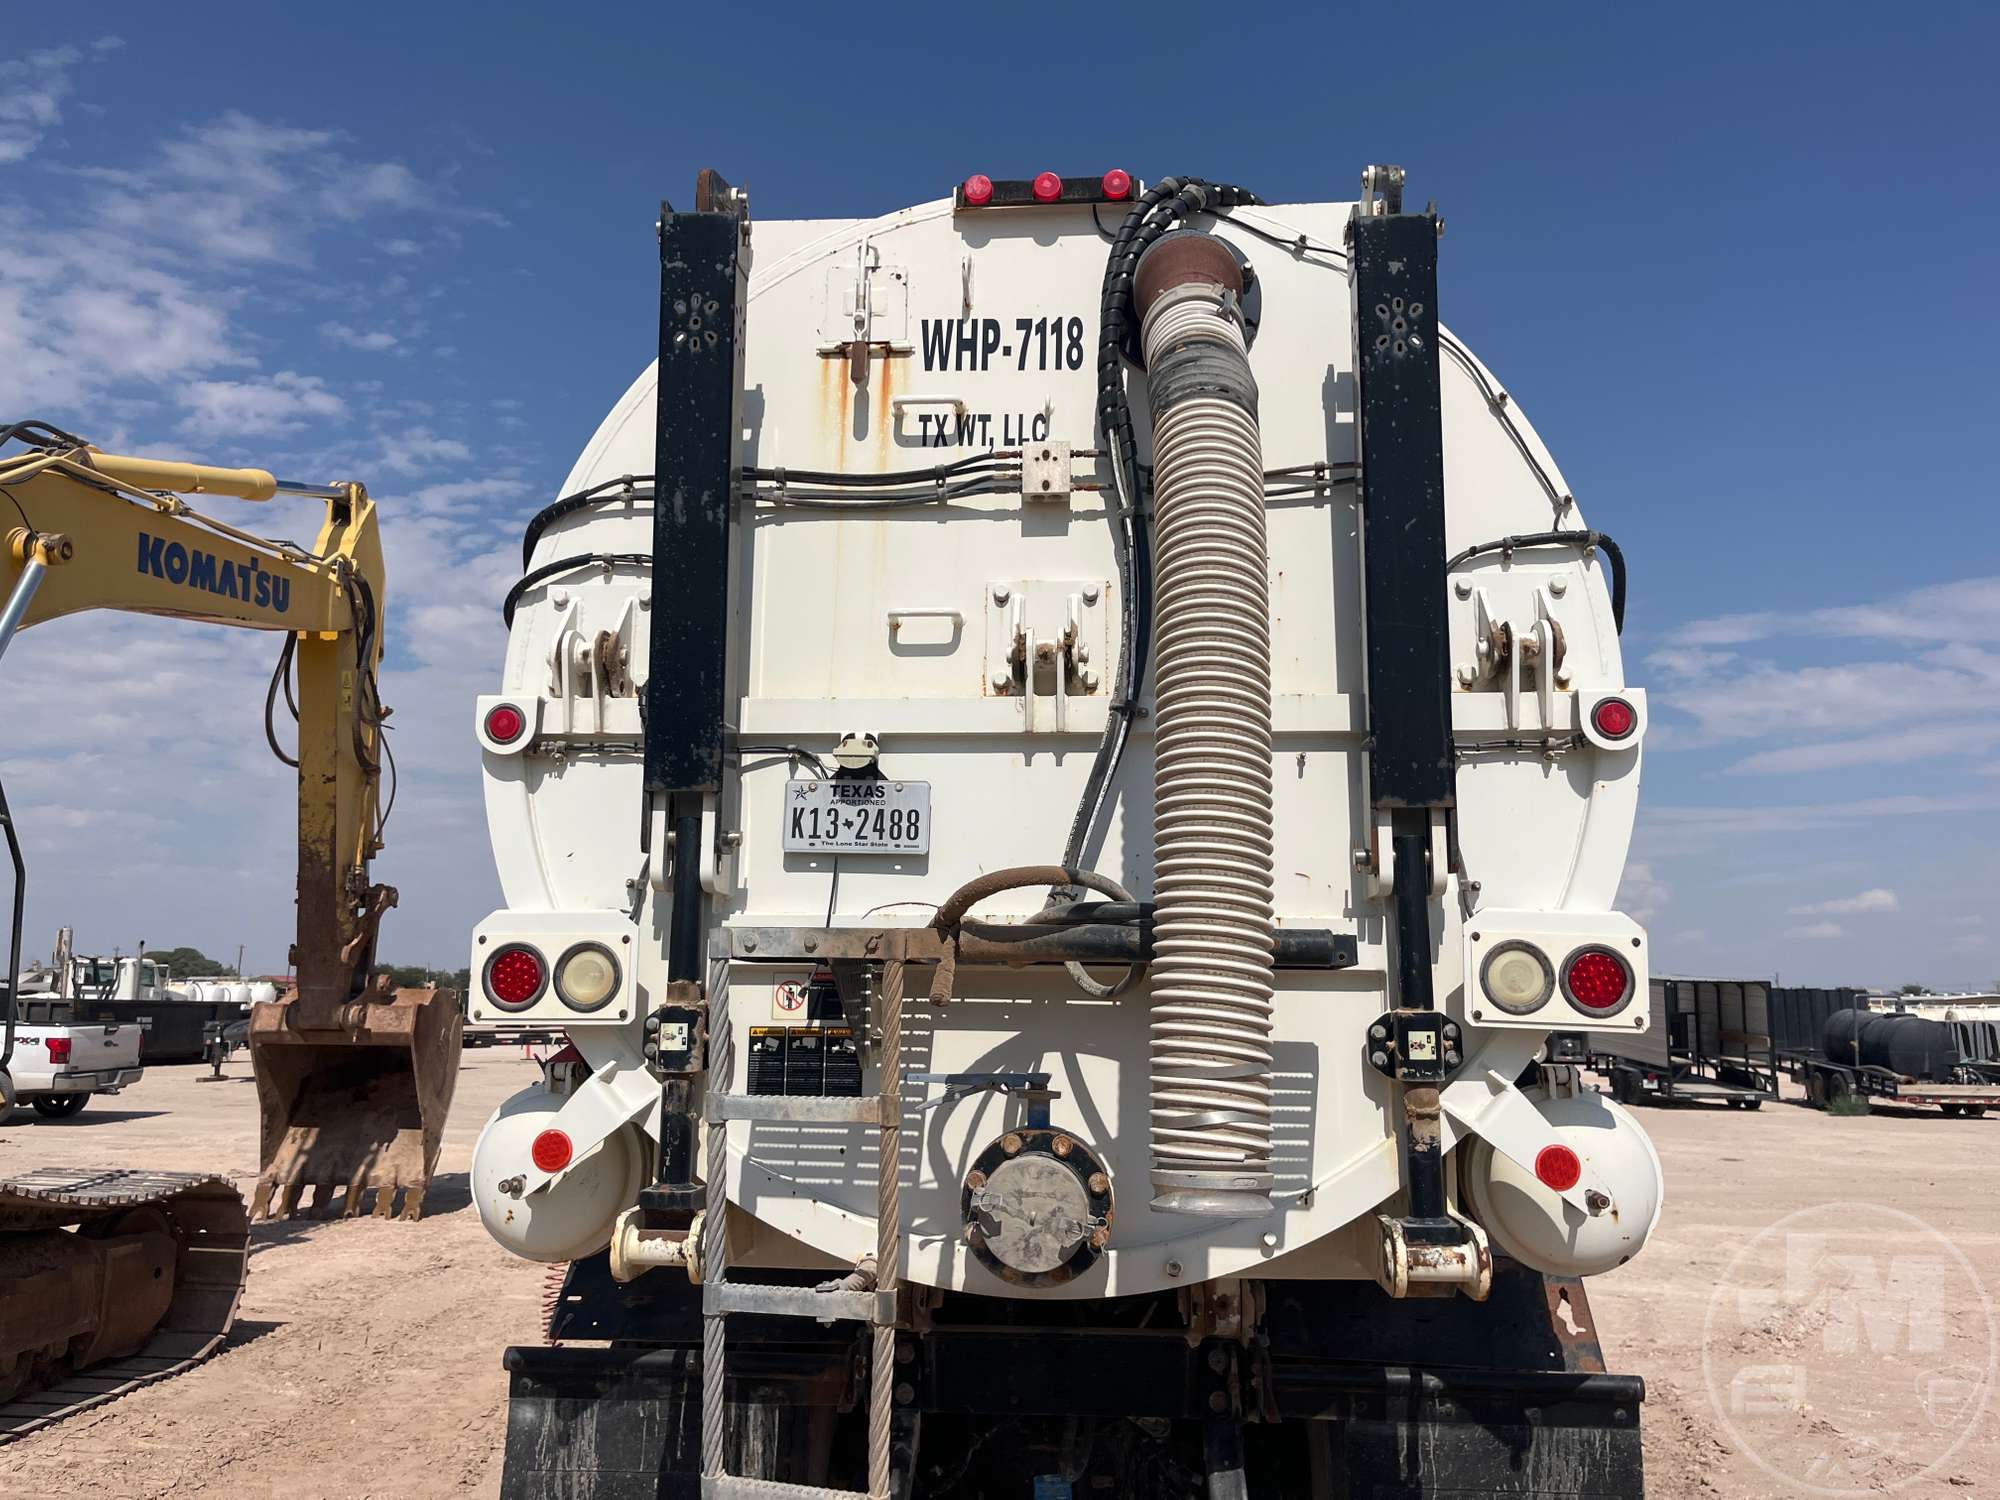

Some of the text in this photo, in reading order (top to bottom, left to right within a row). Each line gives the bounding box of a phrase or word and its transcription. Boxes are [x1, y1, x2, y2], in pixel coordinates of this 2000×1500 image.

[921, 316, 1084, 372] WHP-7118
[918, 414, 949, 448] TX
[1003, 412, 1047, 447] LLC
[138, 532, 290, 613] KOMATSU
[829, 784, 886, 798] TEXAS
